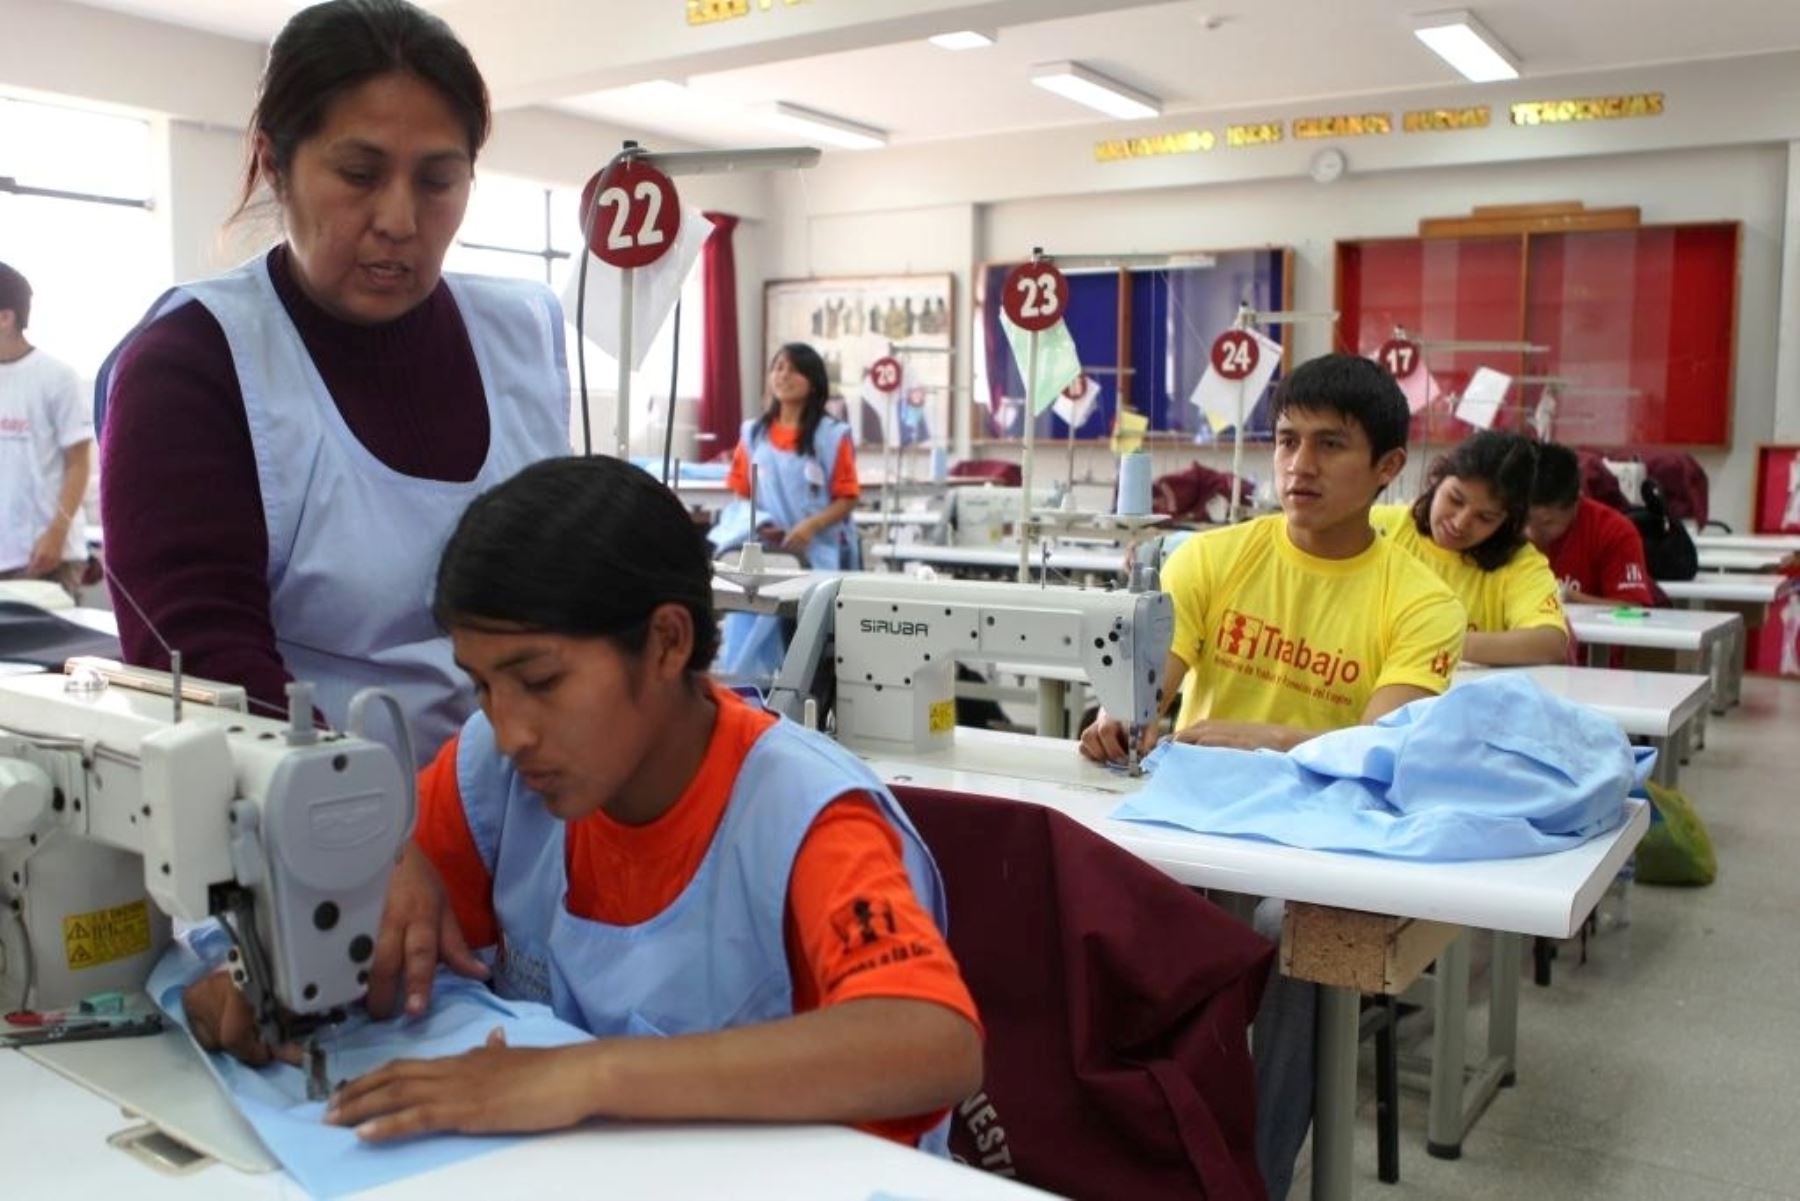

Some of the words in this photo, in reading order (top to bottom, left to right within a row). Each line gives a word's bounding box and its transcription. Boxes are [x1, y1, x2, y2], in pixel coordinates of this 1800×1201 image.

[598, 181, 663, 250] 22
[1017, 272, 1058, 317] 23
[1221, 340, 1251, 371] 24
[1386, 348, 1412, 372] 17
[1263, 625, 1360, 686] Trabajo
